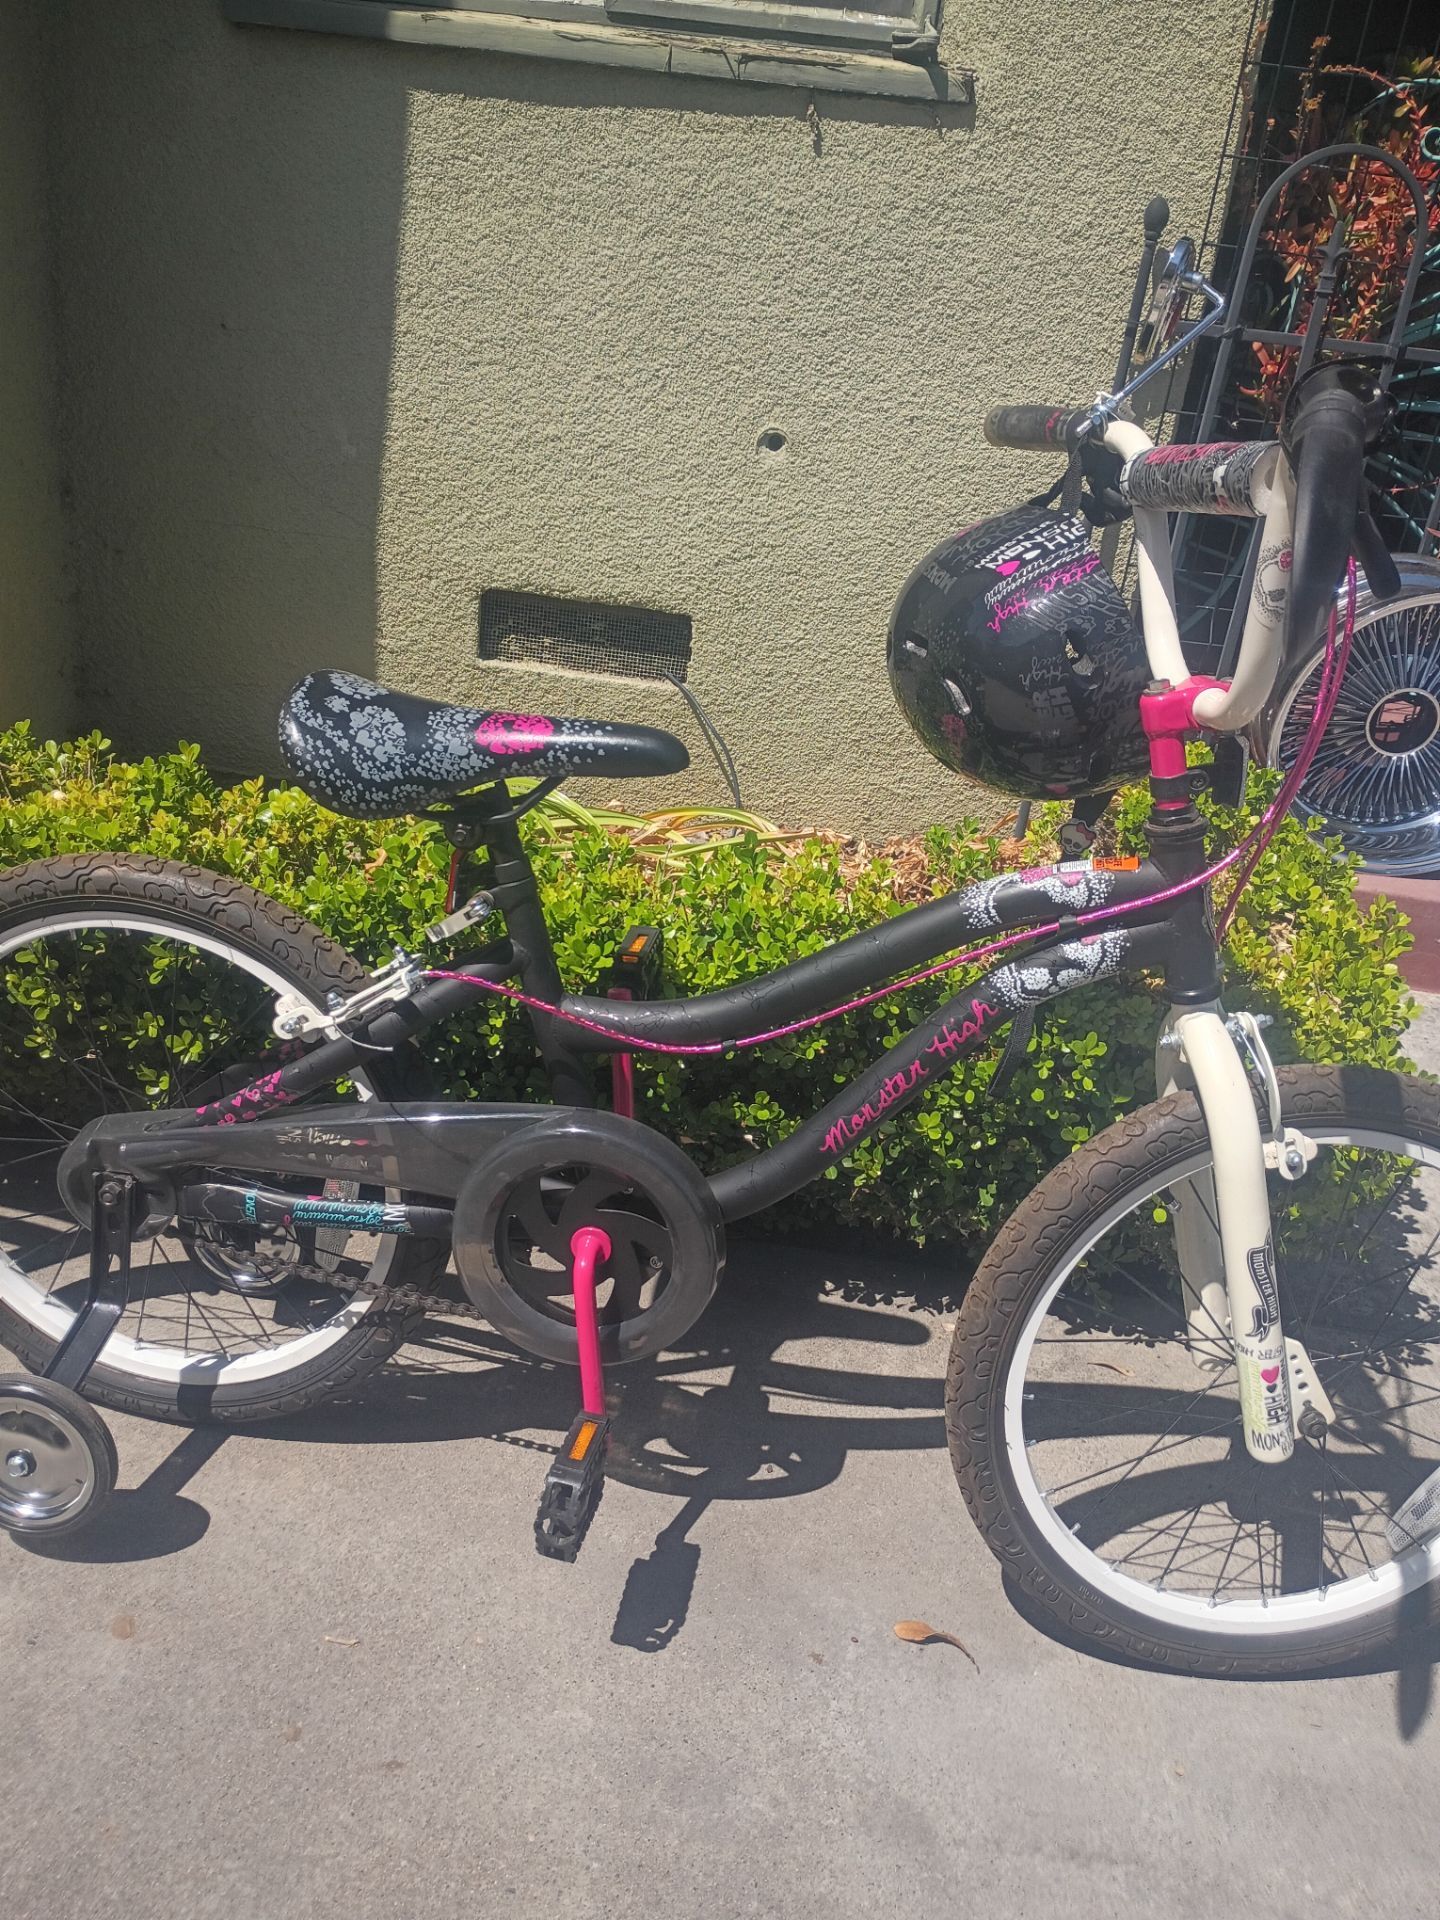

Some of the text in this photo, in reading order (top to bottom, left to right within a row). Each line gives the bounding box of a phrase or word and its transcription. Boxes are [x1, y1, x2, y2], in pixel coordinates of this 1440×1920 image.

[819, 998, 999, 1153] Monster High
[1252, 1252, 1278, 1319] MONSTER HIGH
[1264, 1393, 1284, 1427] HIGH
